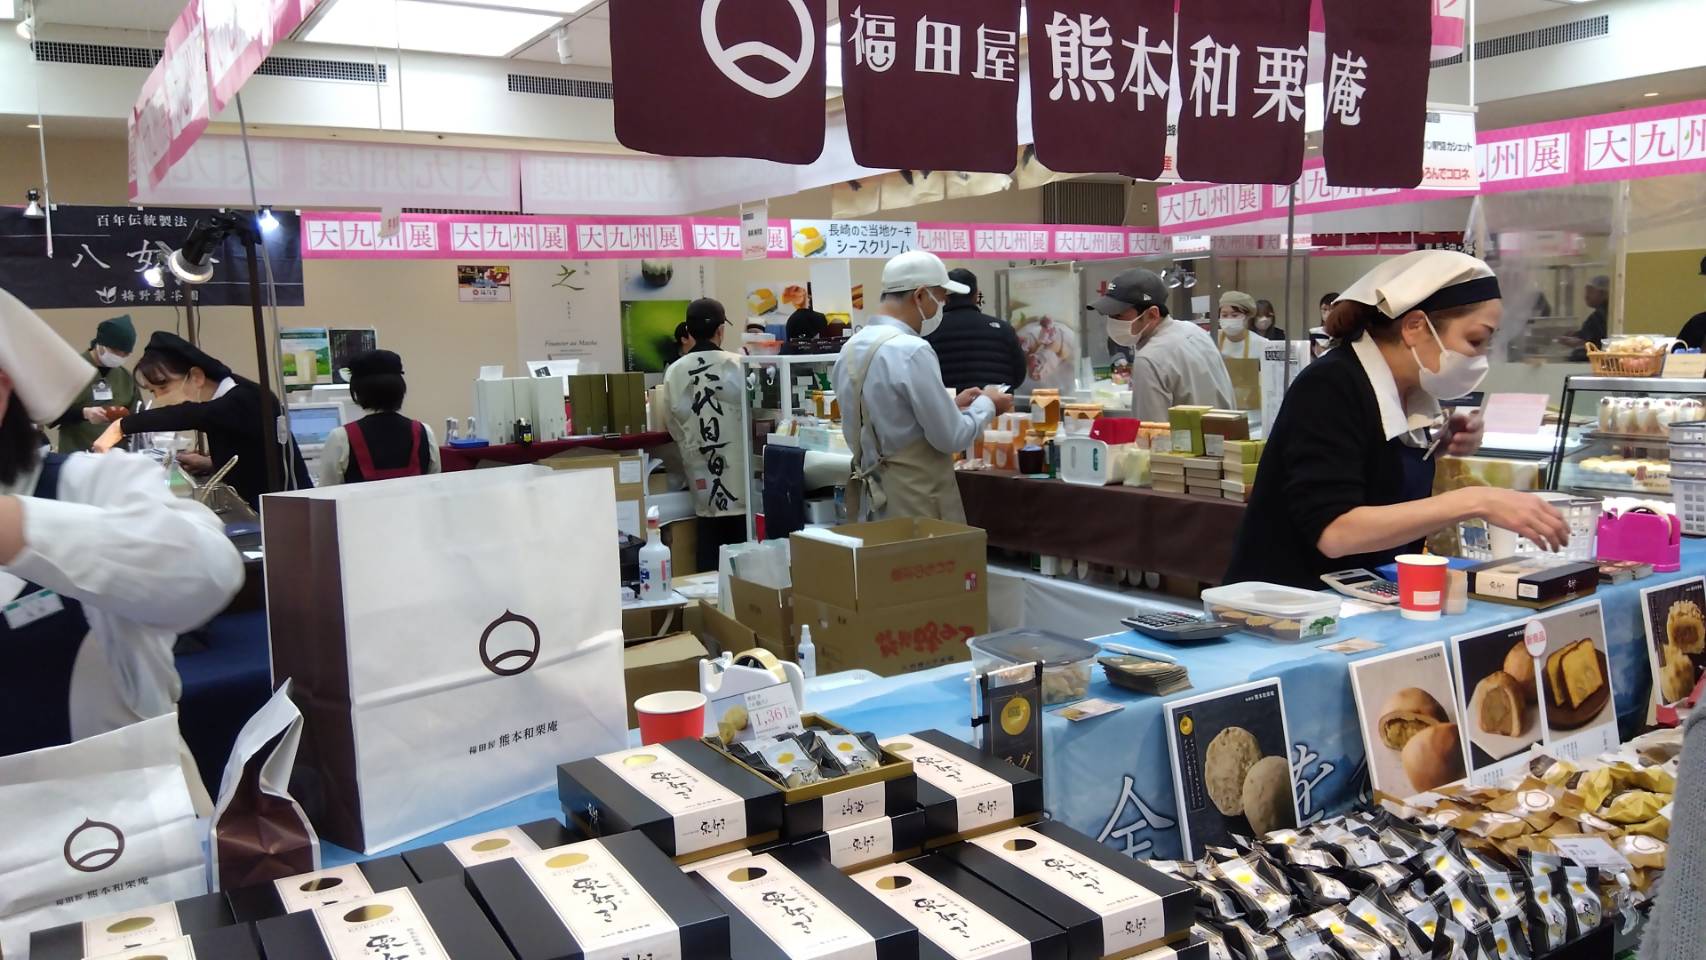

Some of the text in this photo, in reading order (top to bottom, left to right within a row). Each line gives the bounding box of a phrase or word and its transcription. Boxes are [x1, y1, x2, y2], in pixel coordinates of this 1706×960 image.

[848, 6, 1017, 83] 福田屋
[1478, 137, 1561, 178] 州展
[1423, 166, 1471, 181] ろんでコロネ
[1162, 184, 1256, 224] 大九州展
[96, 213, 188, 228] 百年伝統製法
[828, 223, 912, 238] 長崎のご当地ケーキ
[456, 224, 564, 249] 大九州展
[581, 226, 678, 249] 大九州展
[697, 227, 785, 250] 大九展
[837, 239, 911, 255] シースクリーム
[977, 232, 1046, 251] 大九州展
[1058, 232, 1121, 251] 大九州展
[499, 720, 558, 748] 熊本和栗庵
